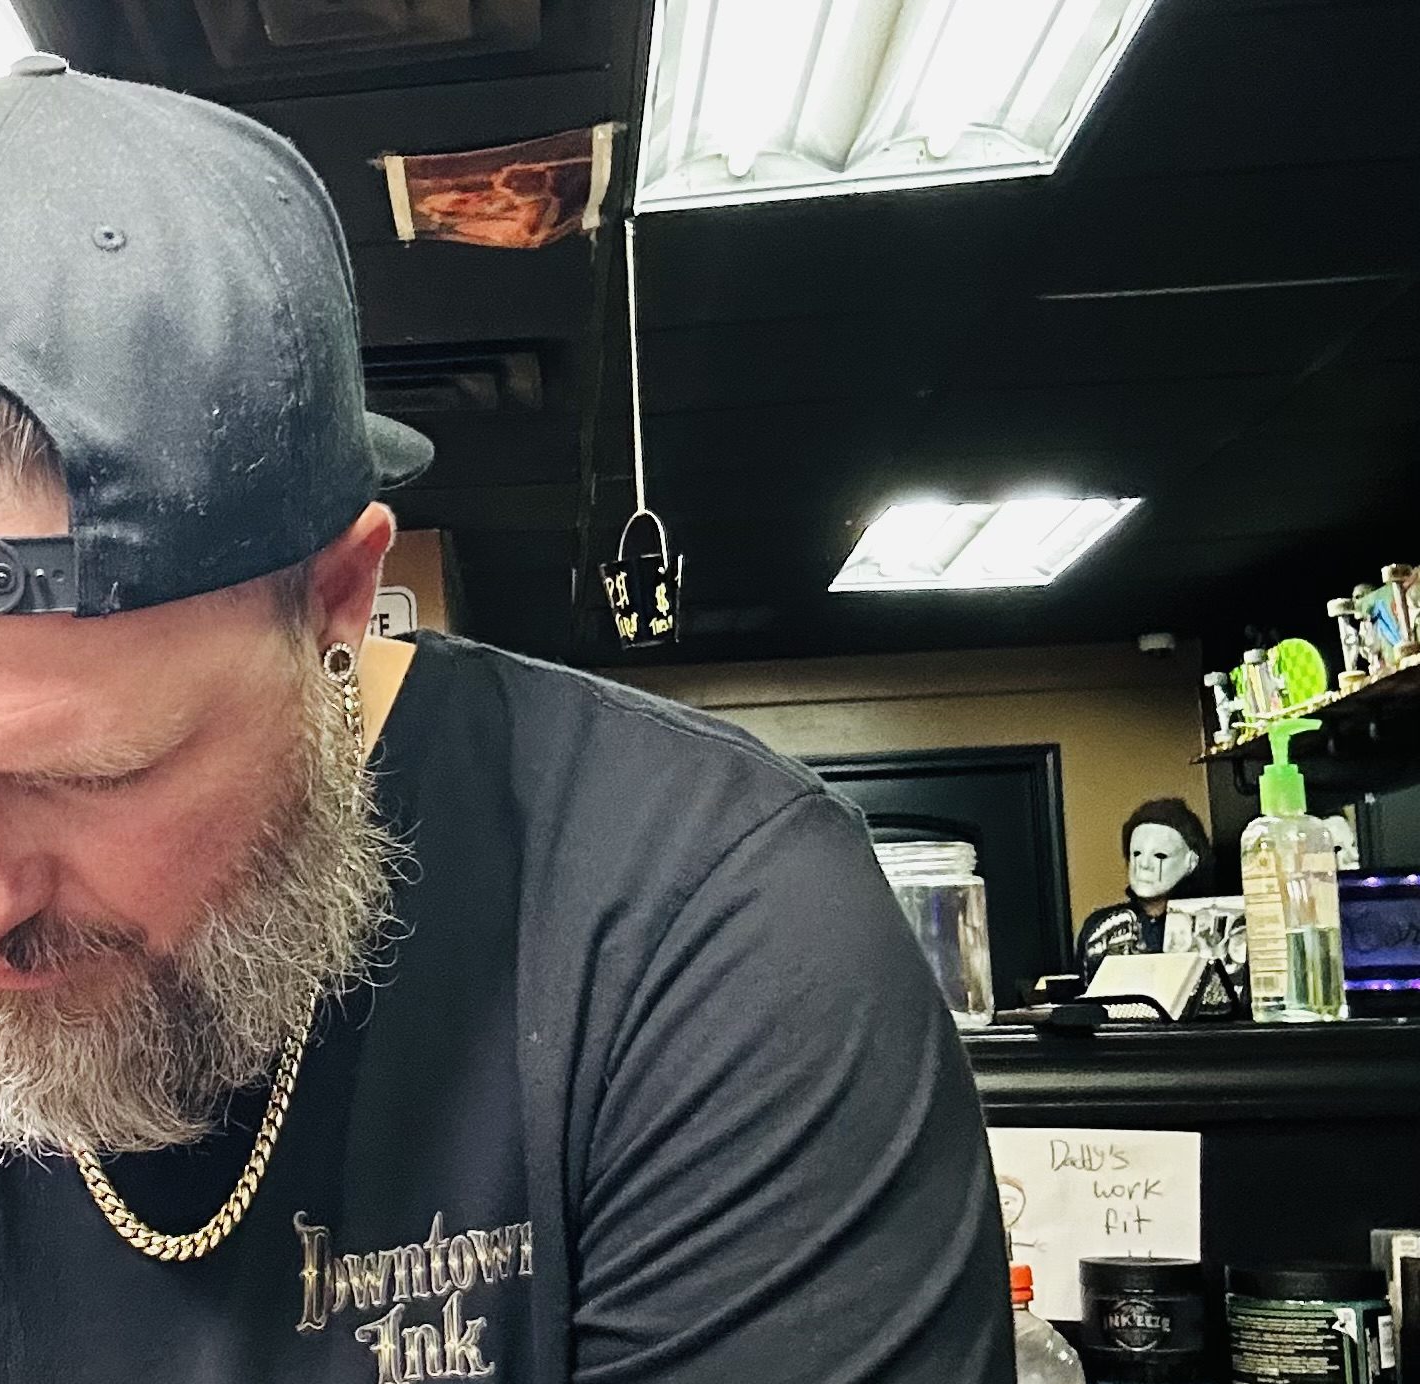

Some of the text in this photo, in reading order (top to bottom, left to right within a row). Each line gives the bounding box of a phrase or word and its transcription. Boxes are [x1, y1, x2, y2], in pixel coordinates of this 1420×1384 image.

[1050, 1138, 1130, 1172] Daddy's
[1093, 1178, 1163, 1201] work
[1105, 1204, 1153, 1236] fit
